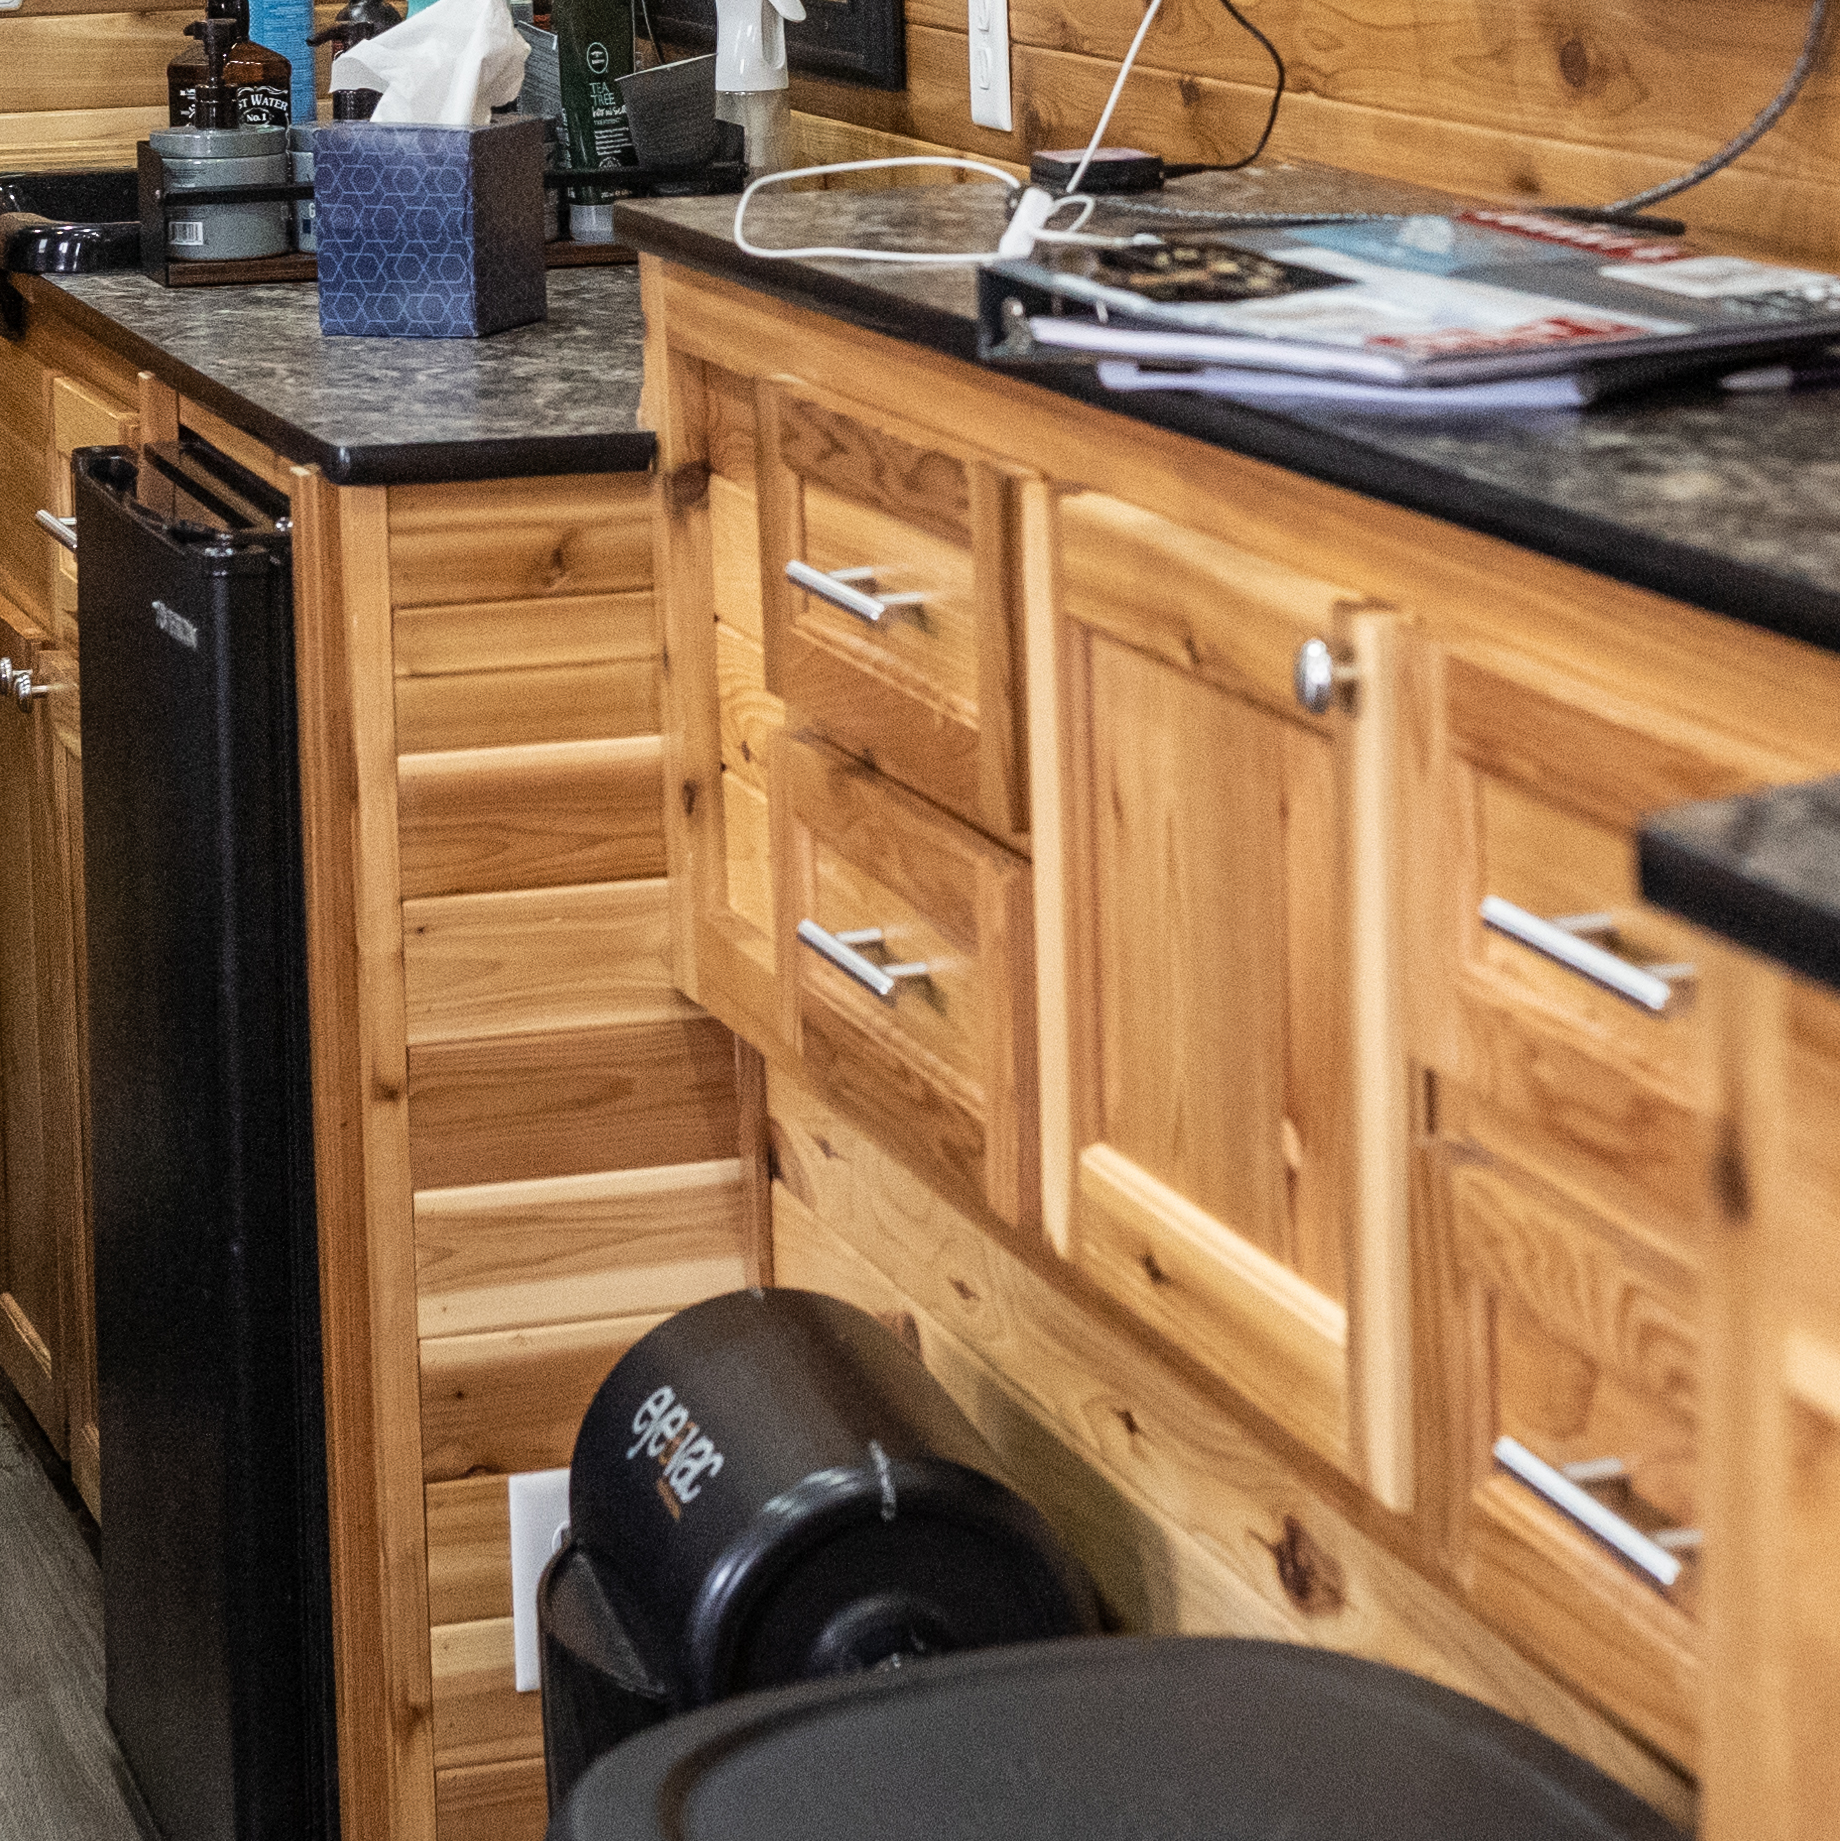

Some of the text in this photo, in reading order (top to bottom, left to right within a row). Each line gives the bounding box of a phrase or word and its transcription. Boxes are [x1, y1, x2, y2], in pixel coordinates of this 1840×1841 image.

[588, 81, 610, 95] TEA
[251, 93, 289, 111] WATER
[589, 91, 616, 107] TREE
